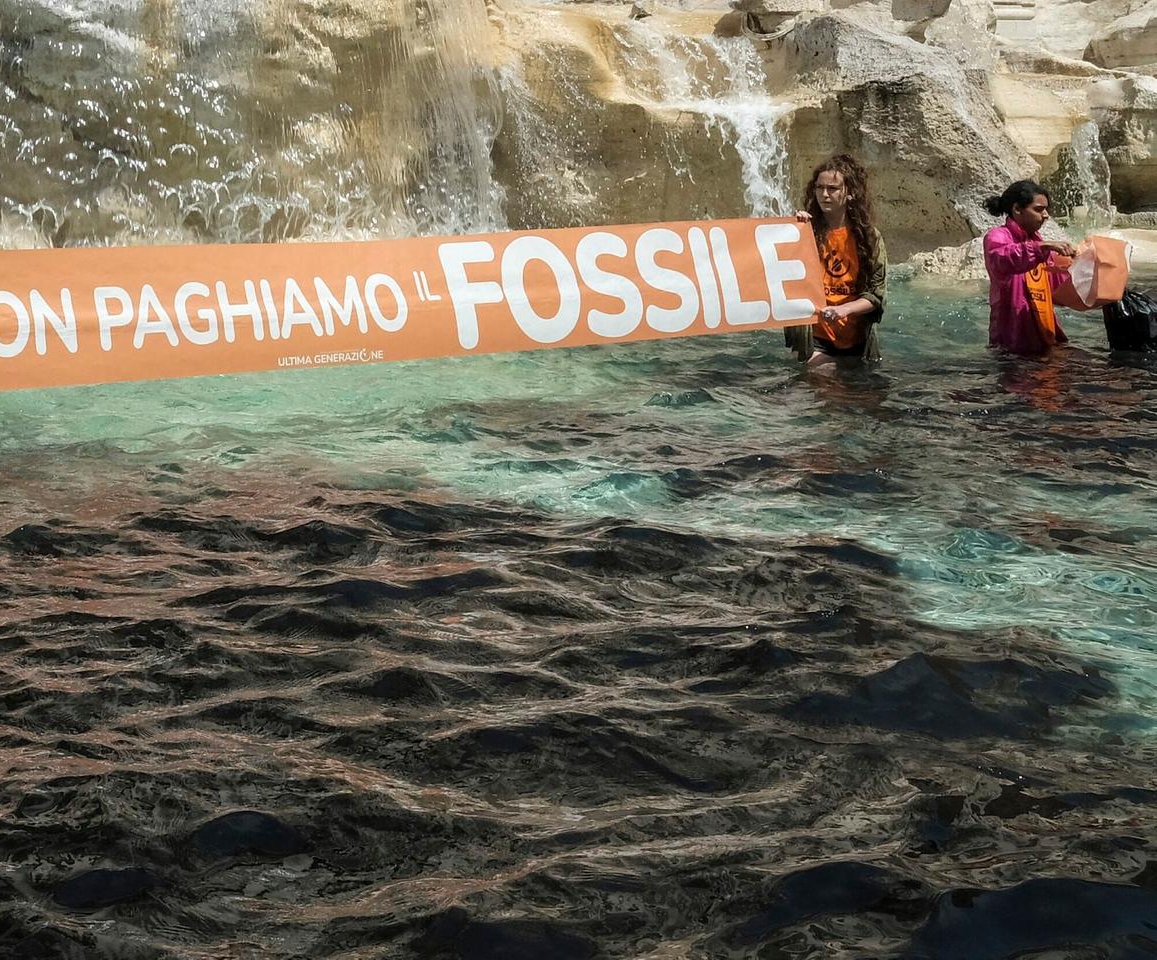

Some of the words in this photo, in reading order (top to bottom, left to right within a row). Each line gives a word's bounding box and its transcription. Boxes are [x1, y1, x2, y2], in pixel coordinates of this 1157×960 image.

[93, 272, 409, 351] PAGHIAMO
[413, 270, 442, 302] IL
[438, 223, 815, 350] FOSSILE
[277, 355, 313, 367] ULTIMA
